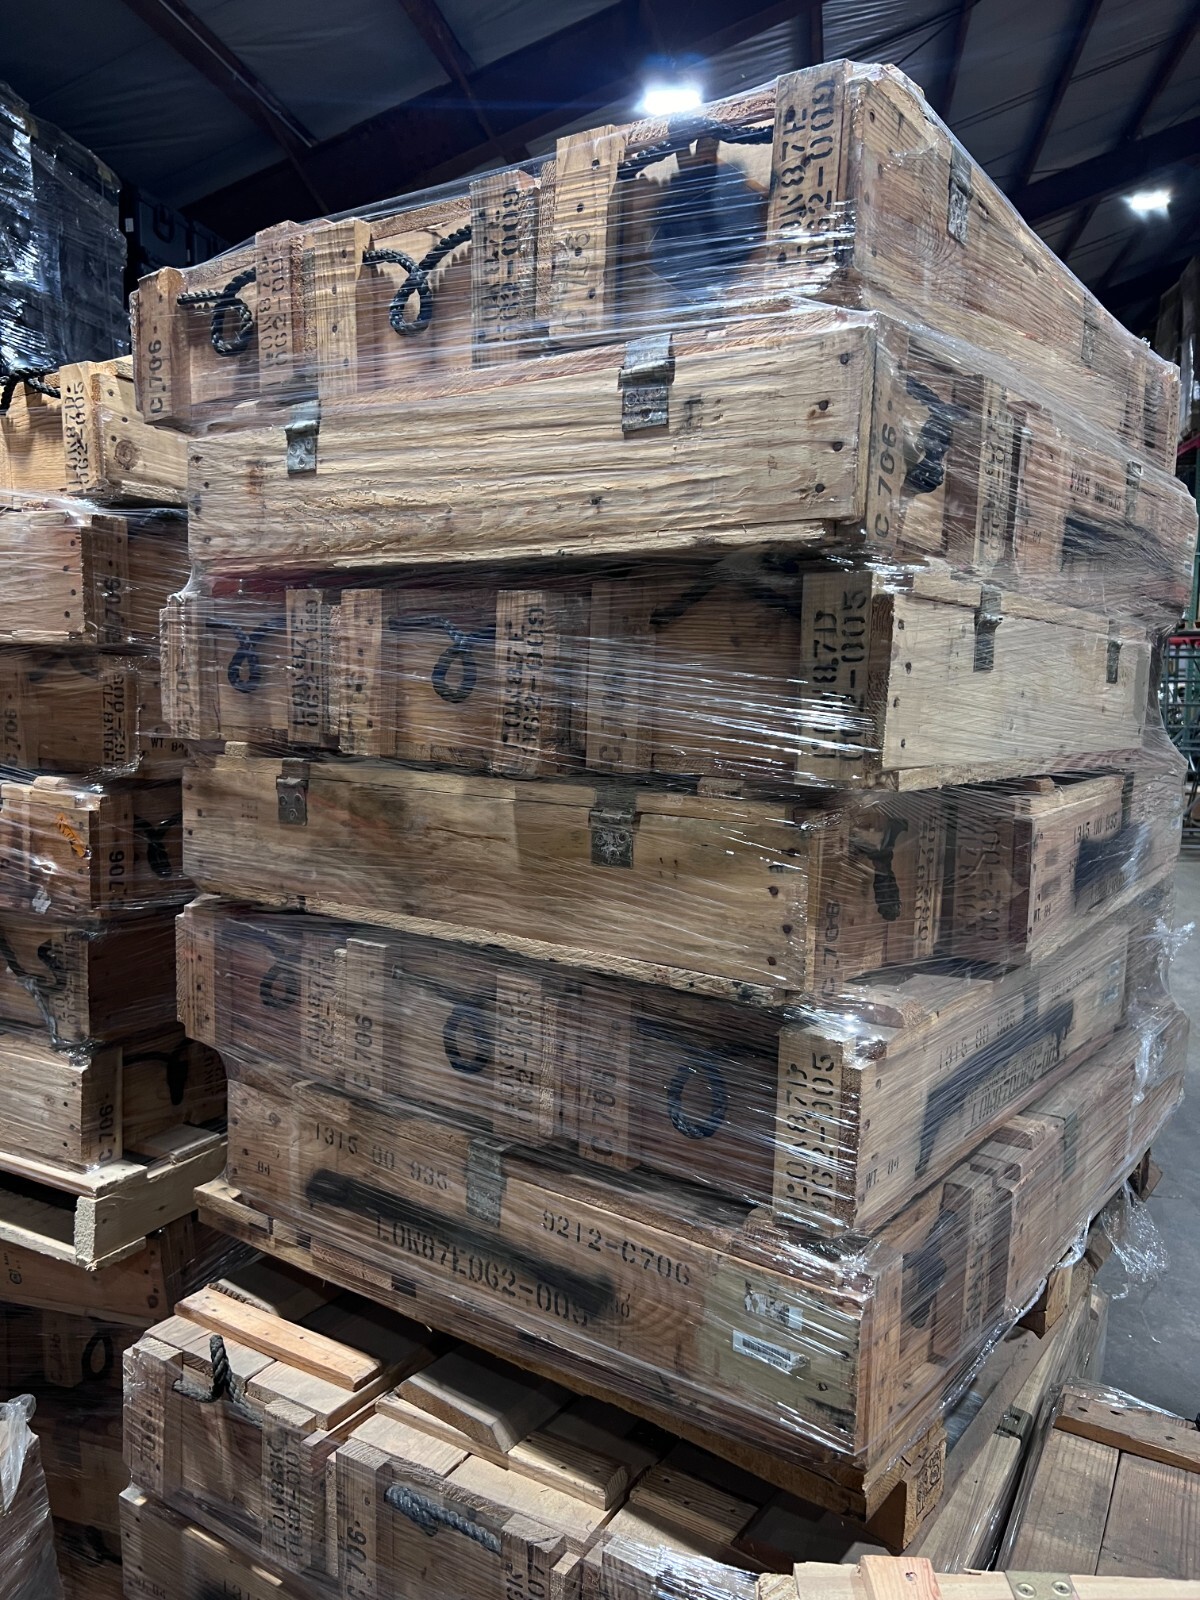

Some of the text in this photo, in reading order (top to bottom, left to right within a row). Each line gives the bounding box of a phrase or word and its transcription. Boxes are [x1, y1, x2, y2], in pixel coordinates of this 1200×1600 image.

[148, 340, 163, 388] 706
[875, 423, 896, 538] C 706
[109, 851, 125, 890] 706
[99, 1105, 114, 1162] C 706
[314, 1122, 358, 1155] 1315
[372, 1145, 395, 1168] 00
[347, 1527, 366, 1576] 706
